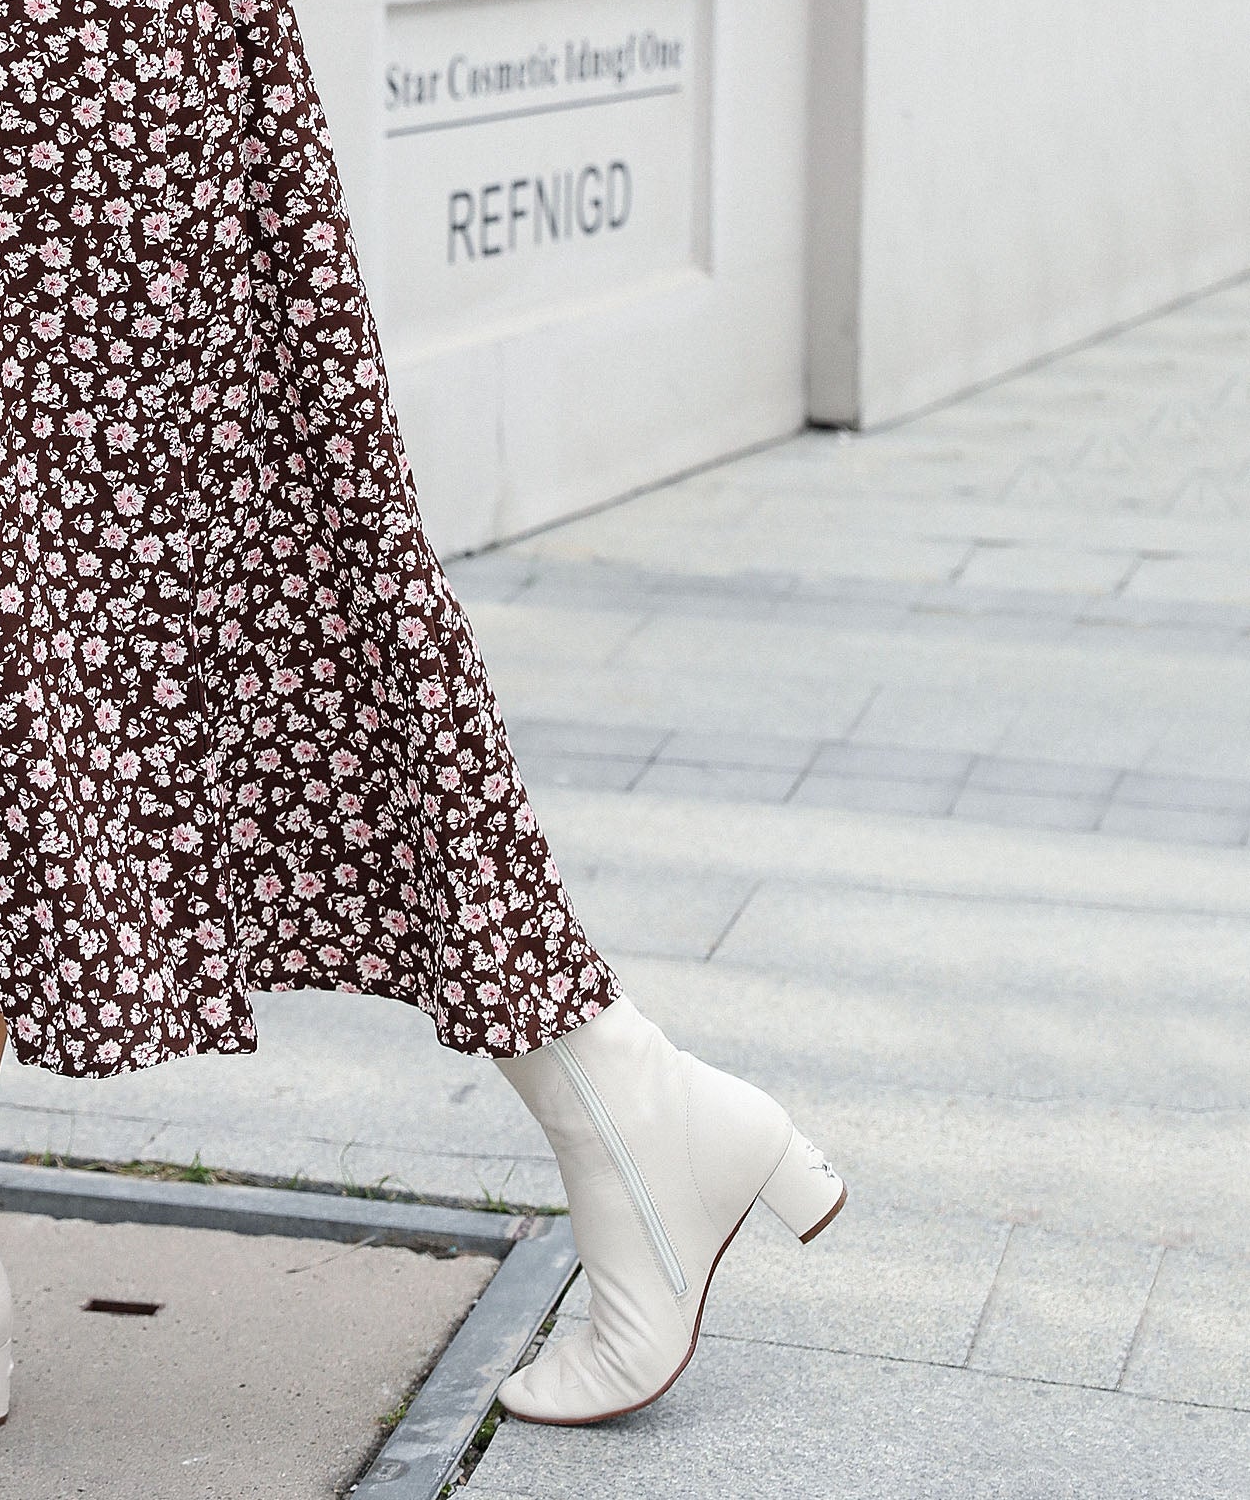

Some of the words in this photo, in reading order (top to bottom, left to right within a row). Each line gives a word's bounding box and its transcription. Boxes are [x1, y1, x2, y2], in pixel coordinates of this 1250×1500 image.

[386, 62, 441, 111] Star
[450, 43, 557, 100] Cosmetic
[447, 159, 632, 265] REFNIGD
